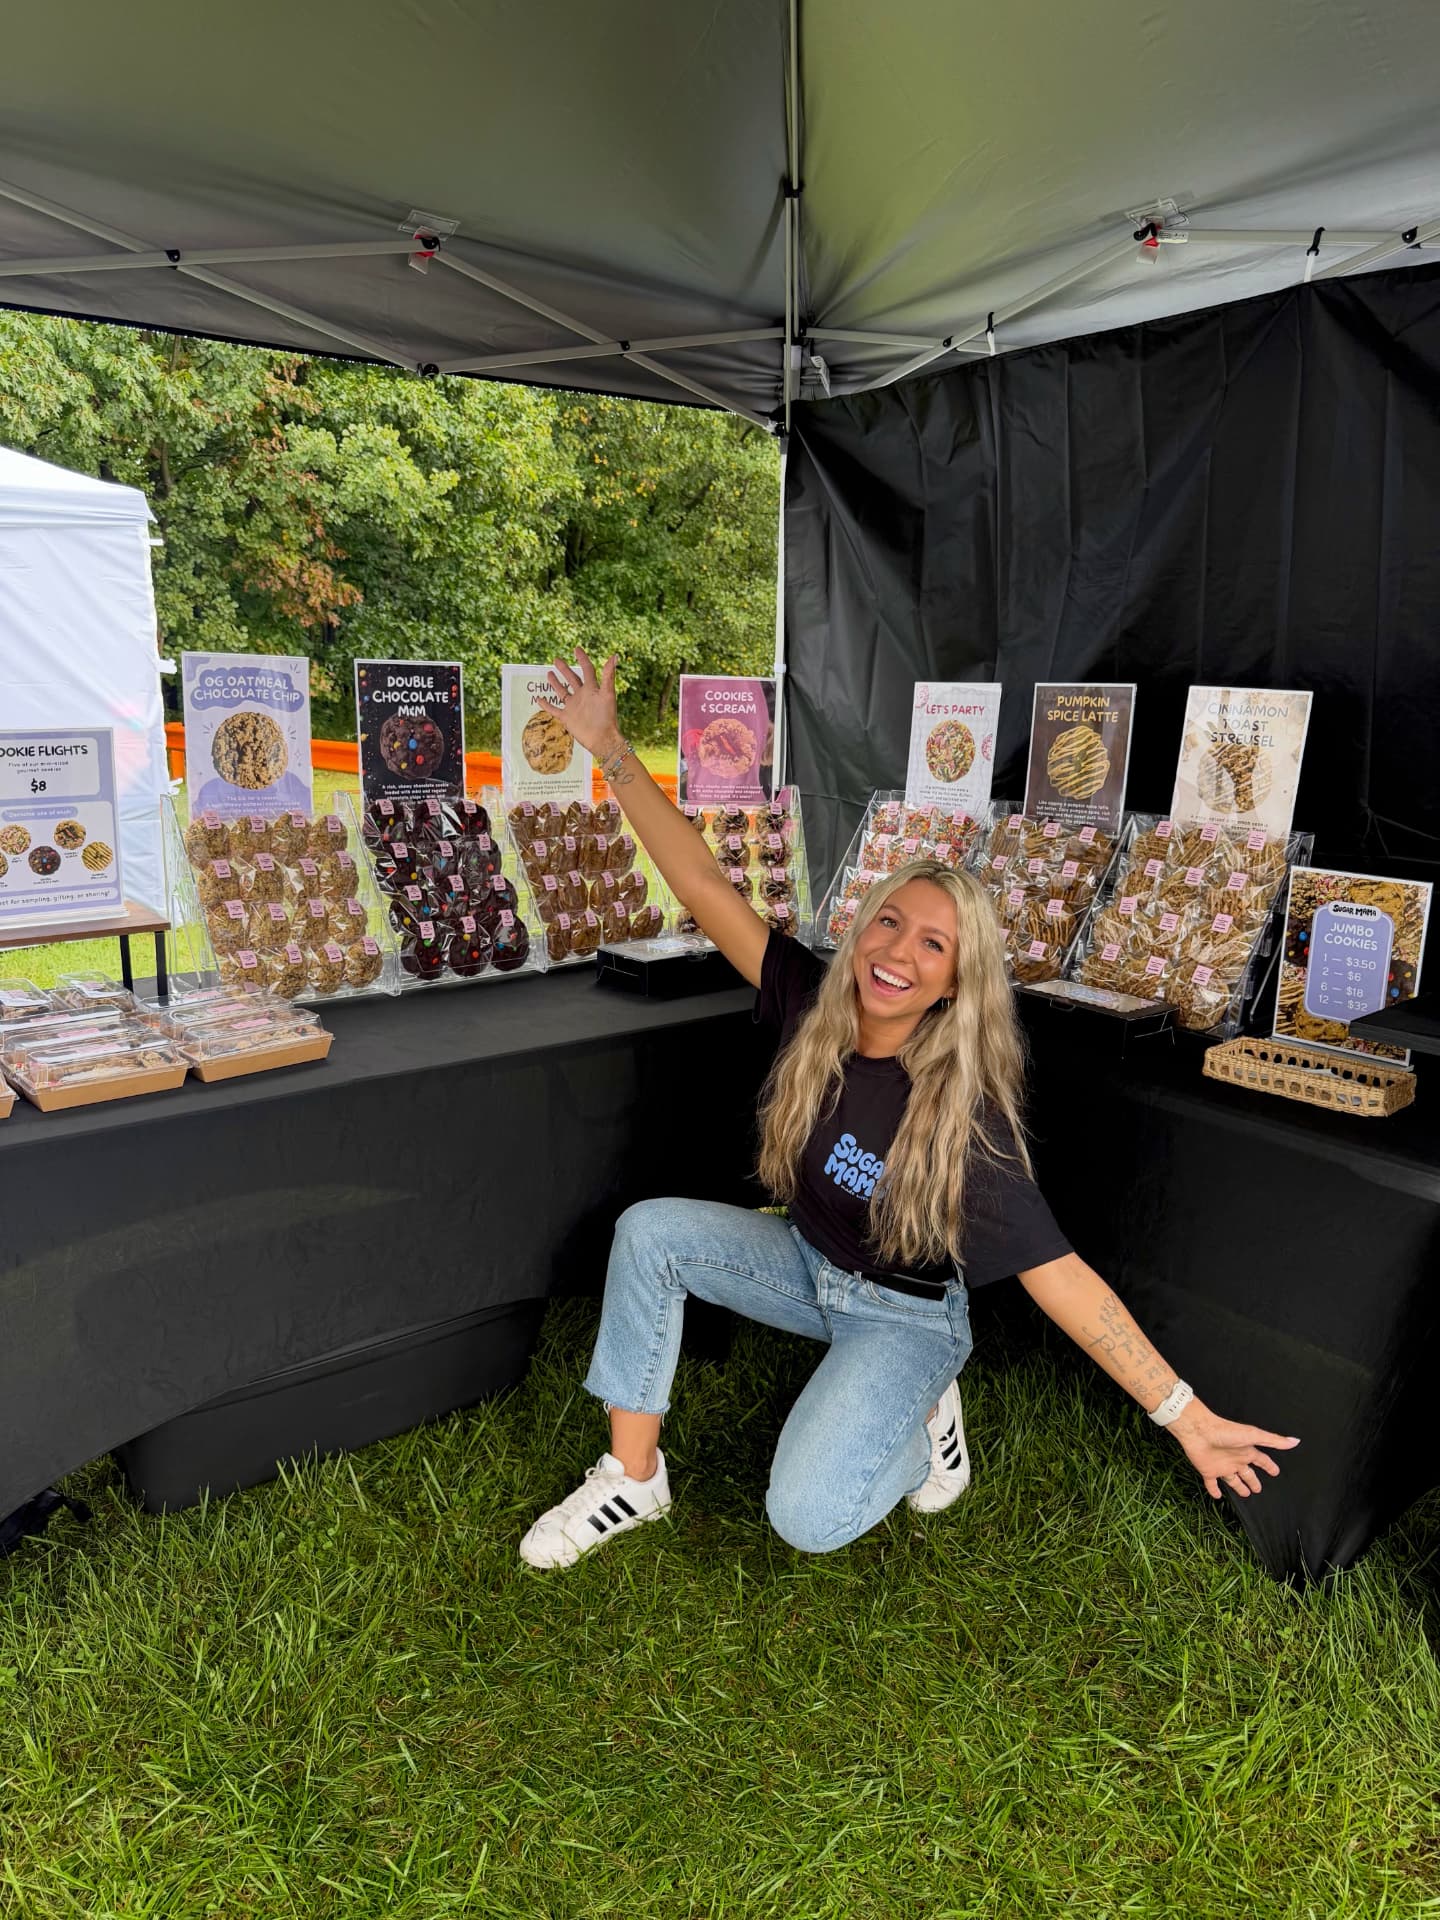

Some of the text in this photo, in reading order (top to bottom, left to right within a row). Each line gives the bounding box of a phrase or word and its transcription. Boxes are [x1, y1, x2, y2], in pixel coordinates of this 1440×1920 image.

[204, 676, 289, 690] OG OATMEAL
[387, 676, 434, 689] DOUBLE
[193, 688, 301, 703] CHOCOLATE CHIP
[372, 690, 449, 703] CHOCOLATE
[704, 690, 754, 702] COOKIES
[1057, 696, 1110, 708] PUMPKIN
[708, 703, 757, 714] SCREAM
[951, 704, 985, 716] PARTY
[1207, 703, 1289, 718] CINNAMON
[1047, 710, 1119, 723] SPICE LATTE
[1223, 718, 1269, 732] TOAST
[1210, 731, 1275, 747] STREUSEL
[0, 745, 88, 757] OOKIE FLIGHTS
[31, 777, 47, 793] $8
[1330, 922, 1375, 938] JUMBO
[1324, 933, 1378, 951] COOKIES
[1345, 956, 1377, 970] $3.50
[1321, 966, 1362, 982] 2 $6
[1319, 994, 1368, 1012] 12 $32
[833, 1133, 885, 1180] SUGA
[823, 1153, 876, 1197] MAM
